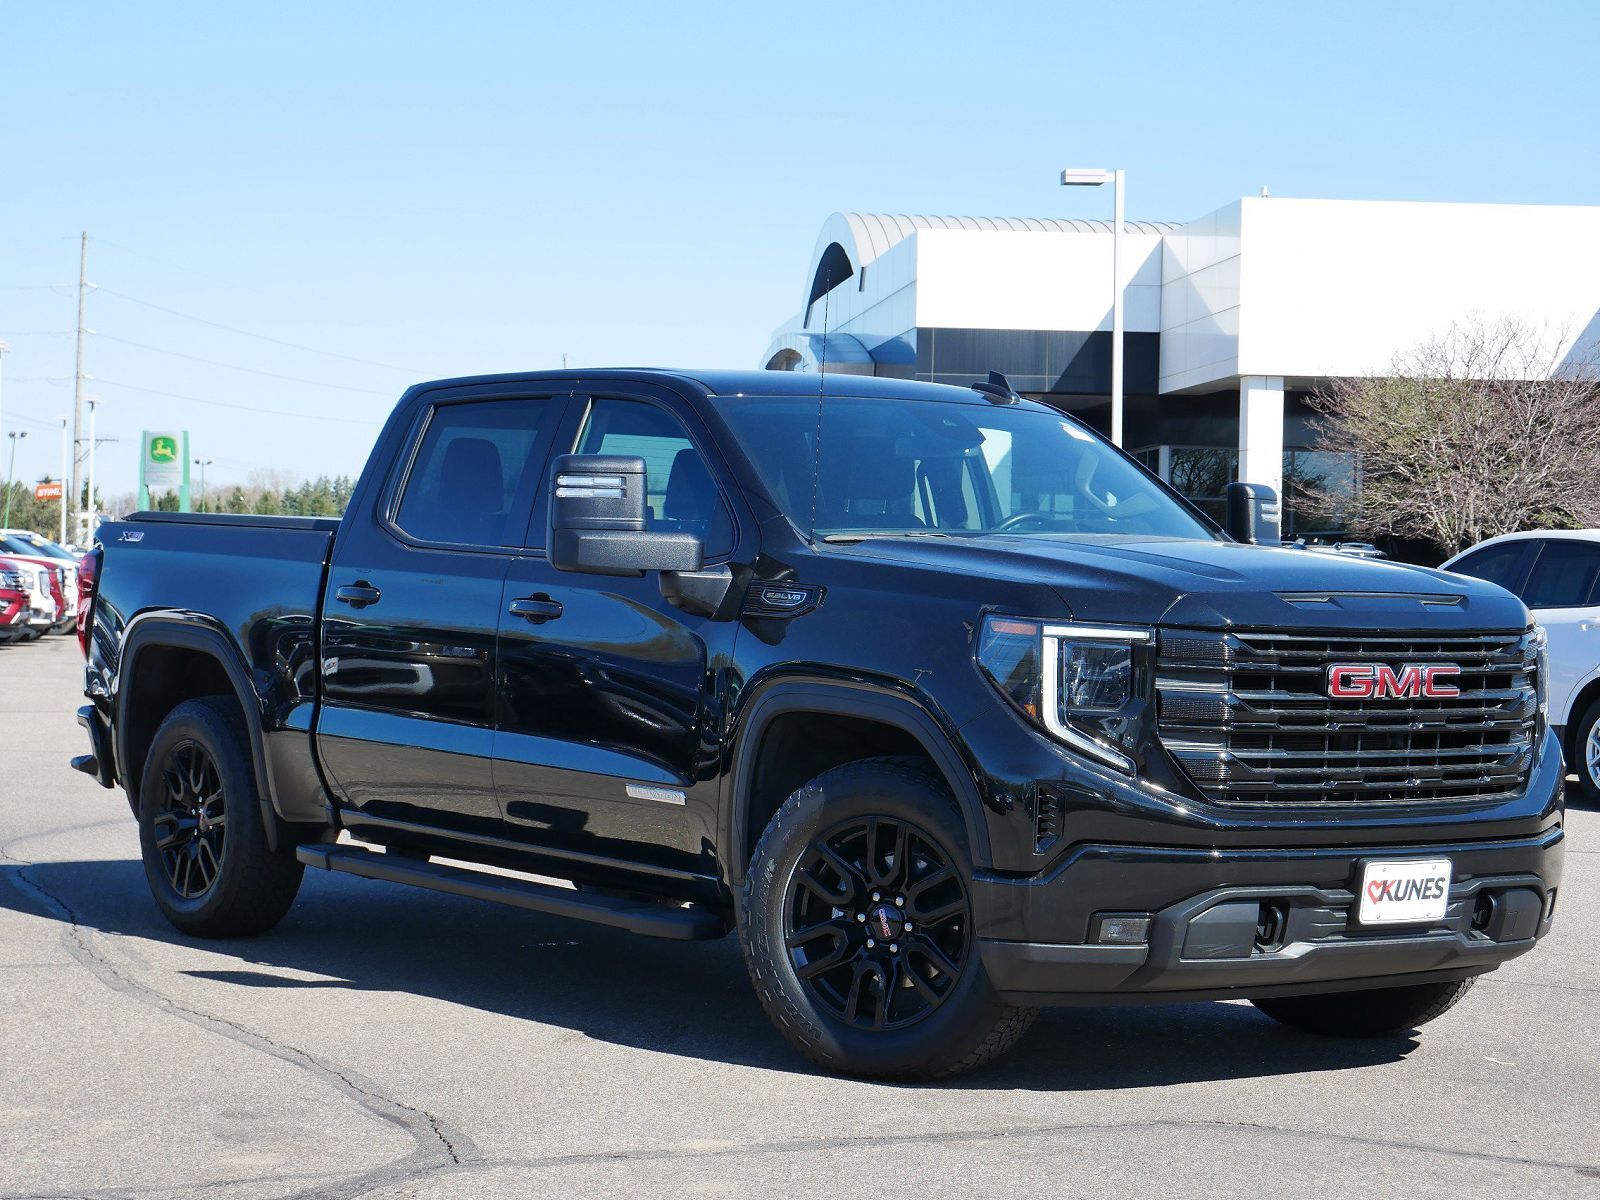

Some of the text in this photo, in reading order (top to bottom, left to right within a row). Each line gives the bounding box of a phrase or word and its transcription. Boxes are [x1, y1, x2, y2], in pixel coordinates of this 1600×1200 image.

[1327, 664, 1461, 699] GMC
[1377, 877, 1446, 902] KUNES
[879, 908, 891, 937] GMC
